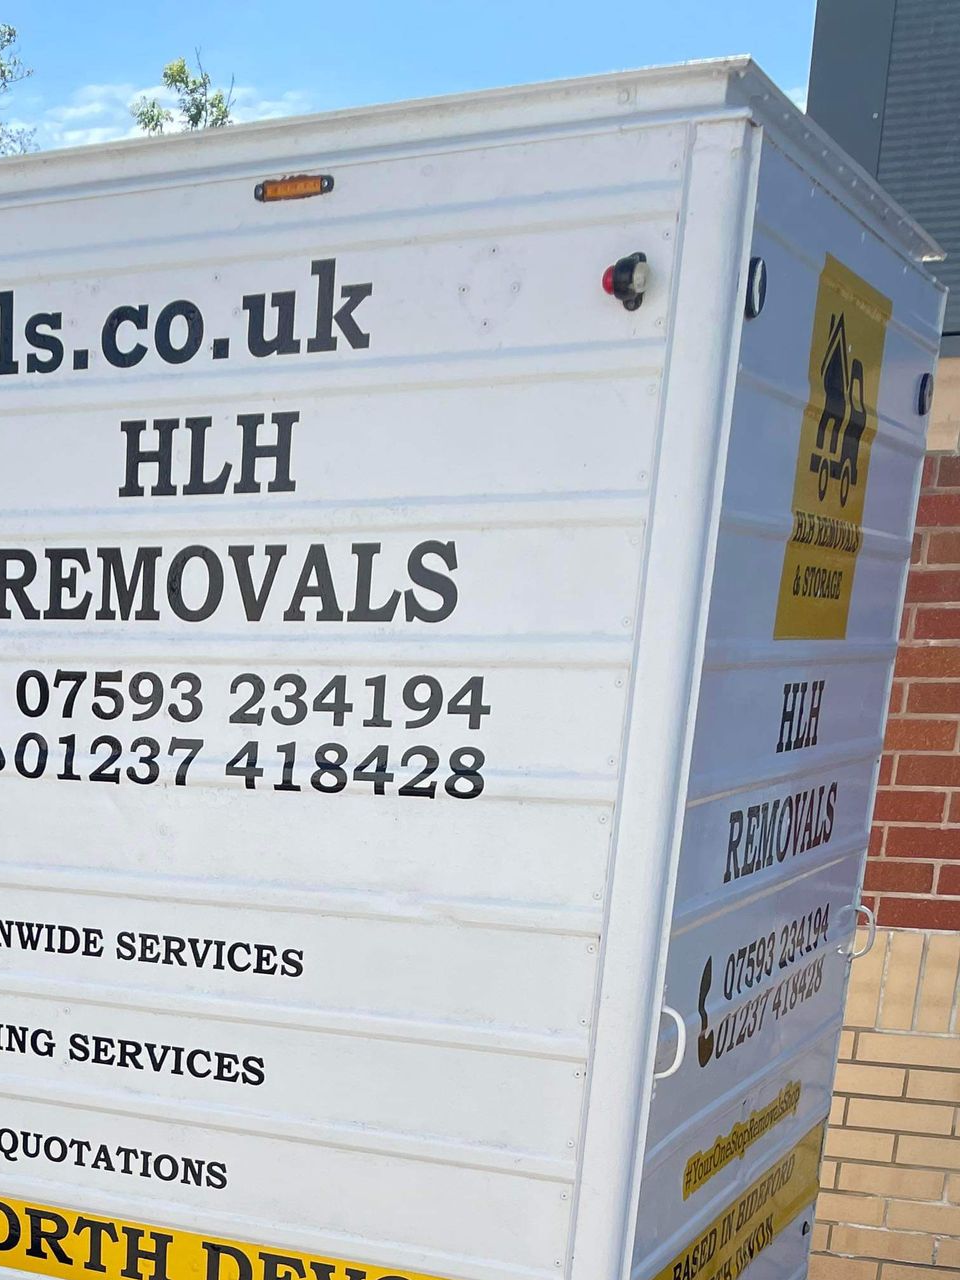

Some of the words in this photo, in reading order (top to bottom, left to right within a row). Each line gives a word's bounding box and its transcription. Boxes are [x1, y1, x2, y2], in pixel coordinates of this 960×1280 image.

[119, 411, 300, 497] HLH
[793, 511, 816, 545] HLH
[815, 516, 861, 553] REMOVALS
[793, 564, 801, 597] &
[802, 566, 843, 600] STORAGE
[16, 668, 203, 723] 07593
[229, 673, 491, 730] 234194
[776, 679, 825, 753] HLH
[14, 732, 204, 787] 01237
[225, 741, 485, 800] 418428
[723, 781, 838, 884] REMOVALS
[116, 931, 304, 978] SERVICES
[724, 931, 776, 1001] 07593
[778, 902, 830, 969] 234194
[715, 986, 775, 1060] 01237
[771, 953, 826, 1021] 418428
[68, 1033, 265, 1086] SERVICES
[719, 1209, 736, 1250] IN
[735, 1153, 796, 1233] BIDEFORD
[735, 1213, 774, 1272] DEVON
